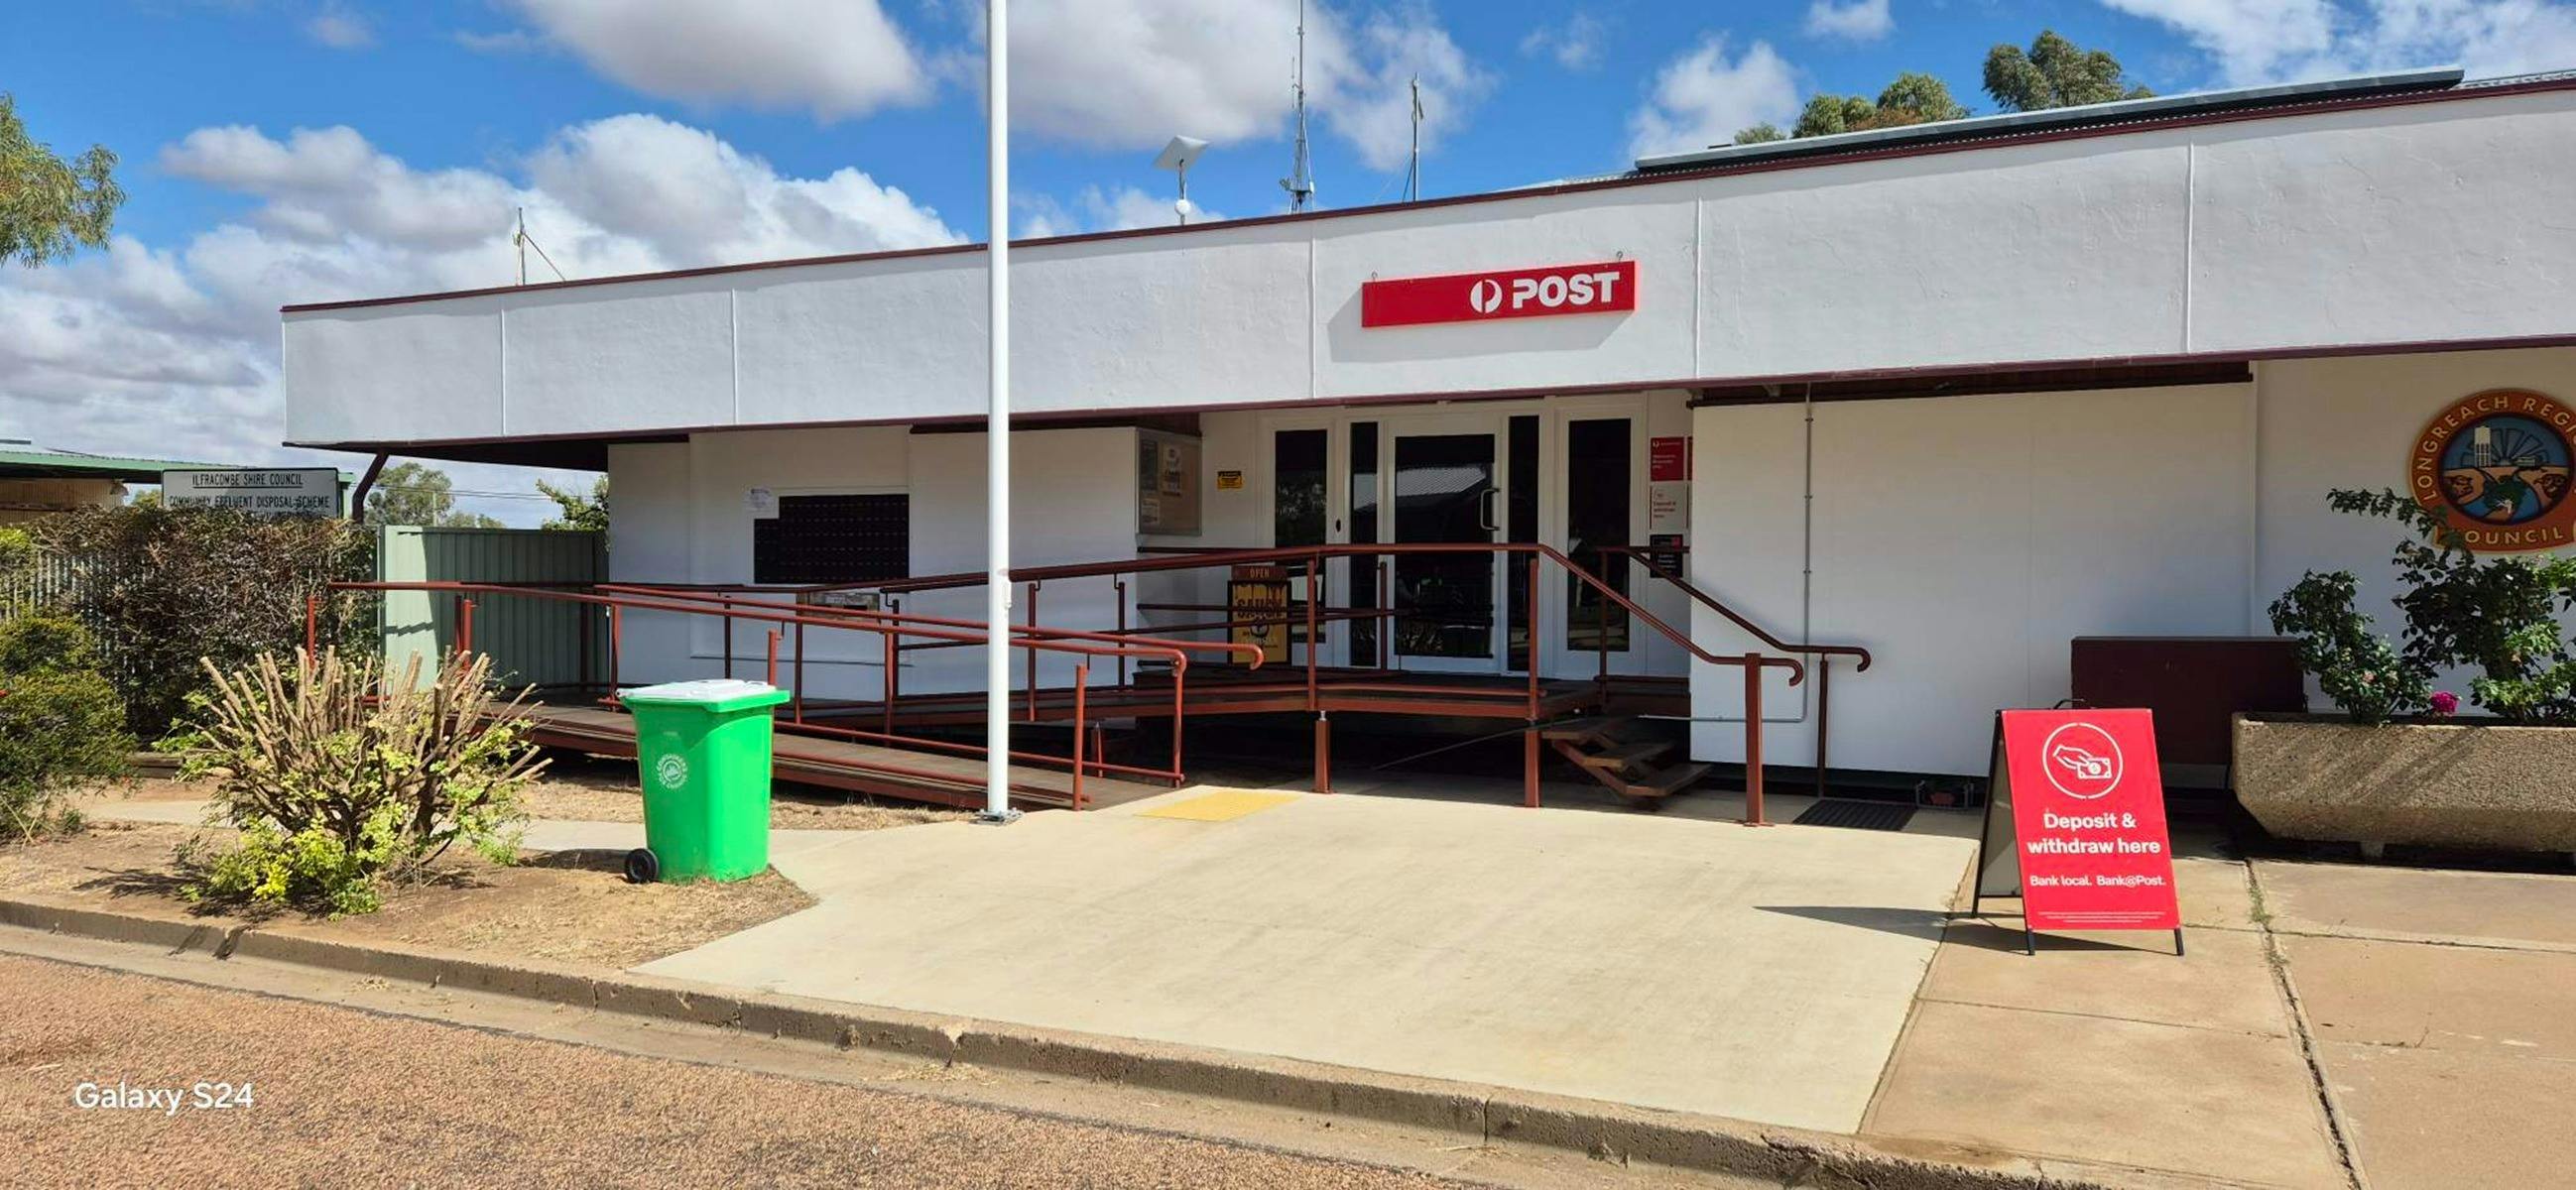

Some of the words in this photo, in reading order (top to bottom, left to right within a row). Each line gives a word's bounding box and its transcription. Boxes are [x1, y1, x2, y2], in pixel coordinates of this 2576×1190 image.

[1512, 271, 1620, 309] POST
[2416, 396, 2510, 501] LONGREACH
[2522, 397, 2576, 446] REGI
[191, 473, 240, 486] ILFRACOMBE
[243, 473, 266, 486] SHIRE
[269, 472, 305, 486] COUNCIL
[214, 495, 253, 509] EFFLUENT
[256, 495, 295, 509] DISPOSAL
[2464, 527, 2564, 545] OUNCIL
[1250, 566, 1270, 578] OPEN
[2042, 811, 2119, 832] Deposit
[2121, 812, 2137, 829] &
[2026, 837, 2114, 854] withdraw
[2117, 837, 2161, 854] here
[2029, 874, 2060, 887] Bank
[2061, 874, 2092, 887] local.
[2096, 874, 2166, 889] Bank@Post.
